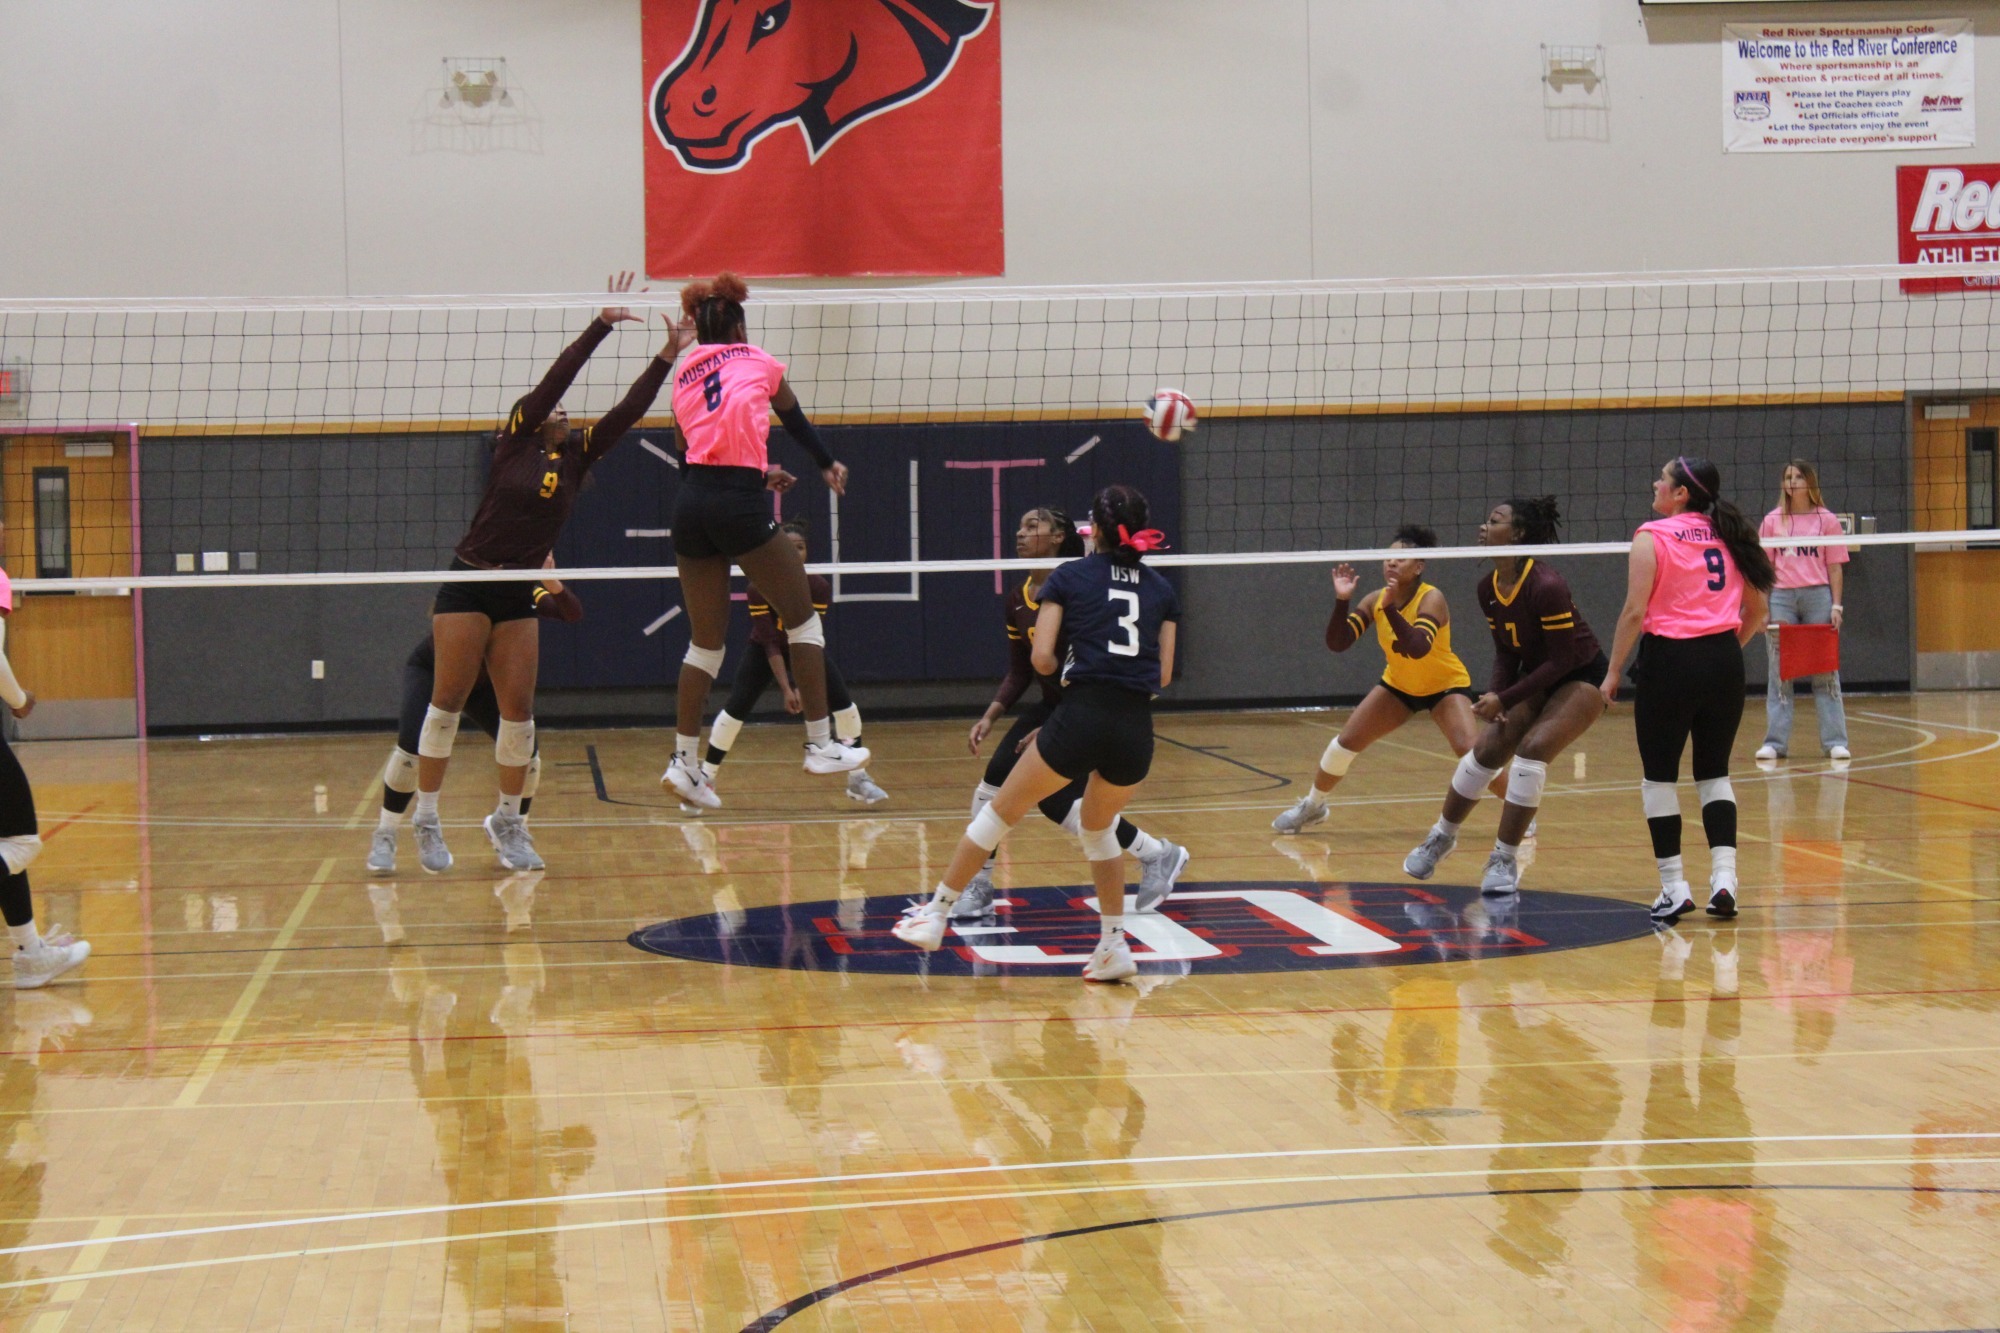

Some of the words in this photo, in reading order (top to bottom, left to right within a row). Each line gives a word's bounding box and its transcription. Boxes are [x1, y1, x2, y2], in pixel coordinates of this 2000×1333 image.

[1762, 28, 1784, 38] Red
[1787, 28, 1815, 37] River
[1819, 26, 1903, 38] Sportsmanship
[1906, 25, 1935, 34] Code
[1738, 40, 1791, 58] Welcome
[1795, 41, 1806, 58] to
[1810, 40, 1828, 57] the
[1832, 38, 1854, 56] Red
[1858, 38, 1887, 56] River
[1891, 36, 1957, 55] Conference
[1780, 62, 1812, 70] Where
[1816, 61, 1891, 71] sportsmanship
[1755, 74, 1817, 84] expectation
[1820, 74, 1828, 82] &
[1831, 73, 1880, 83] practiced
[1884, 73, 1893, 81] at
[1896, 72, 1908, 80] all
[1912, 71, 1944, 80] times.
[1736, 92, 1769, 105] NAIA
[1839, 90, 1854, 98] the
[1856, 89, 1889, 98] Players
[1892, 89, 1911, 97] play
[1834, 100, 1872, 109] Coaches
[1821, 111, 1858, 119] Officials
[1861, 110, 1899, 118] officiate
[1773, 123, 1788, 131] Let
[1791, 123, 1805, 131] the
[1808, 122, 1857, 131] Spectators
[1860, 120, 1884, 130] enjoy
[1887, 120, 1902, 128] the
[1904, 120, 1929, 128] event
[1763, 136, 1778, 145] We
[1781, 135, 1837, 146] appreciate
[1840, 134, 1895, 145] everyone's
[1898, 133, 1937, 143] support
[678, 346, 751, 389] MUSTANGS
[703, 370, 722, 412] 8
[538, 471, 559, 499] 9
[1110, 565, 1140, 584] USW
[1703, 548, 1726, 591] 9
[1108, 588, 1140, 657] 3
[1505, 622, 1522, 648] 7
